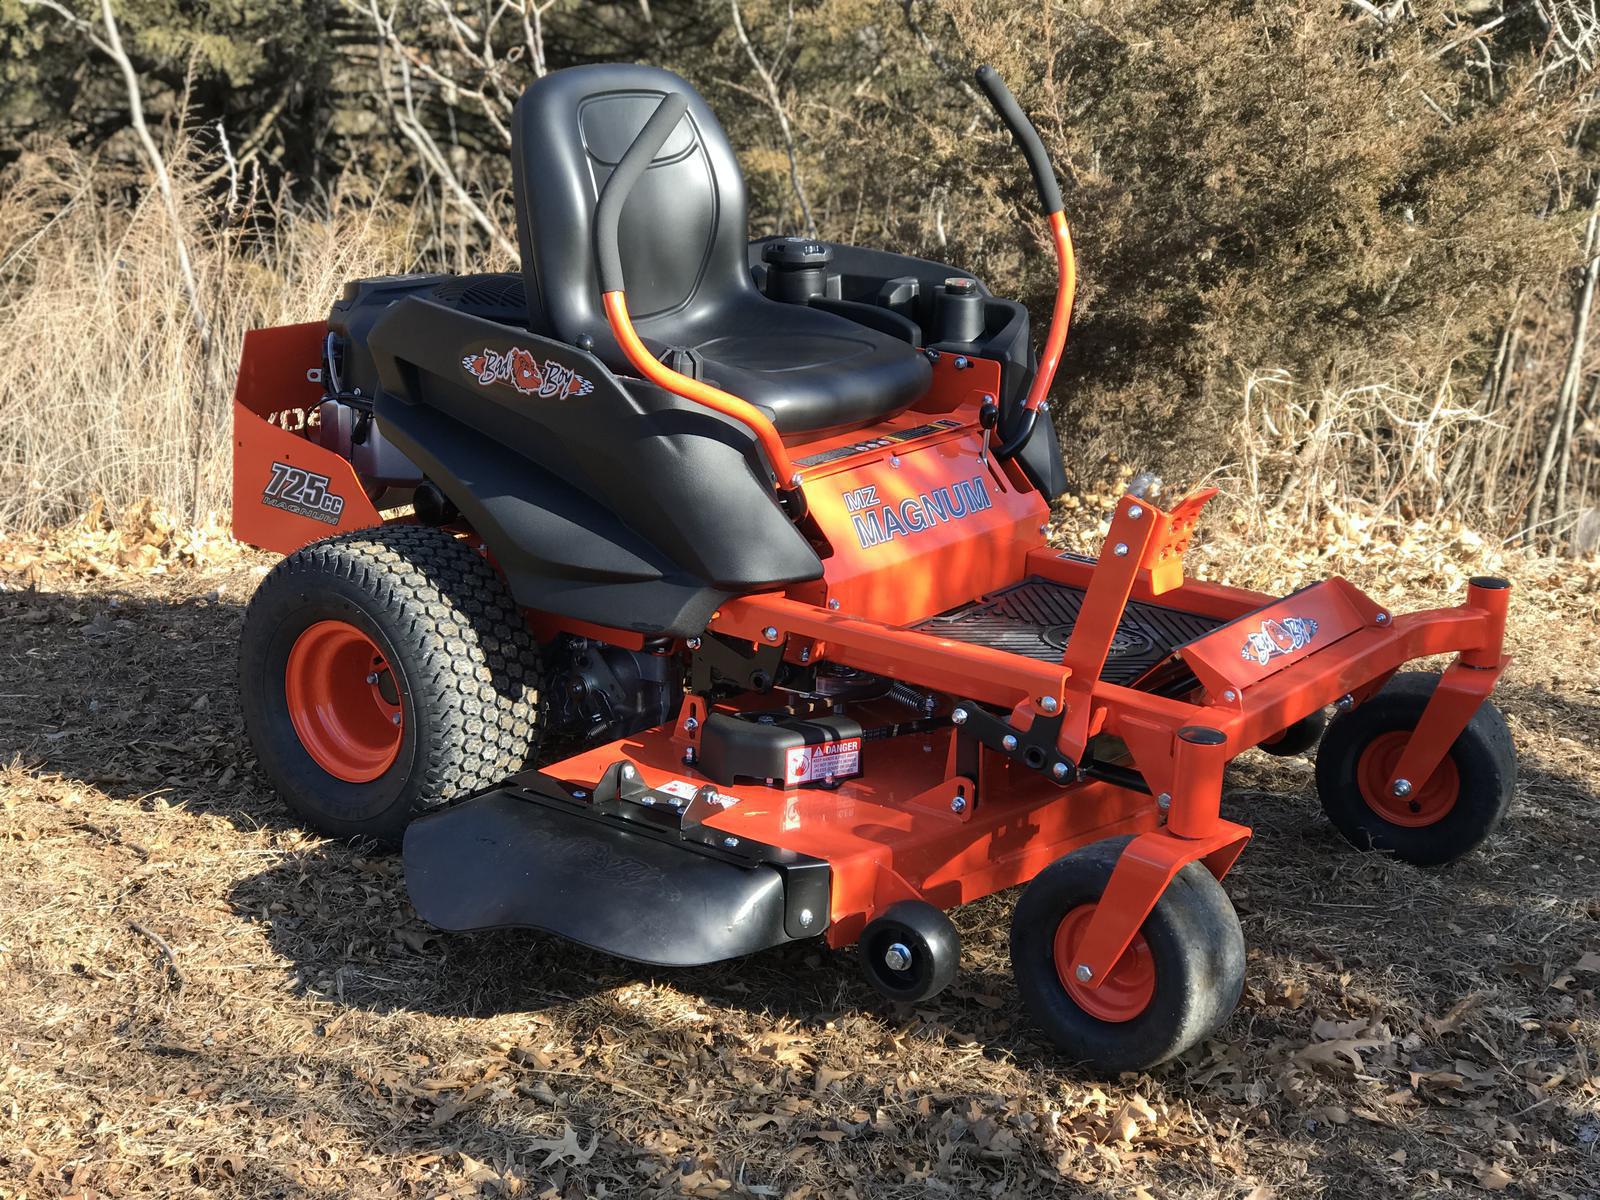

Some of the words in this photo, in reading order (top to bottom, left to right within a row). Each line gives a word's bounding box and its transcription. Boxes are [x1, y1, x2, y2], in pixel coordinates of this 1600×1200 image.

[539, 360, 574, 399] Boy
[263, 496, 339, 525] MAGNUM
[843, 485, 880, 513] MZ
[852, 477, 992, 549] MAGNUM
[826, 742, 858, 754] DANGER
